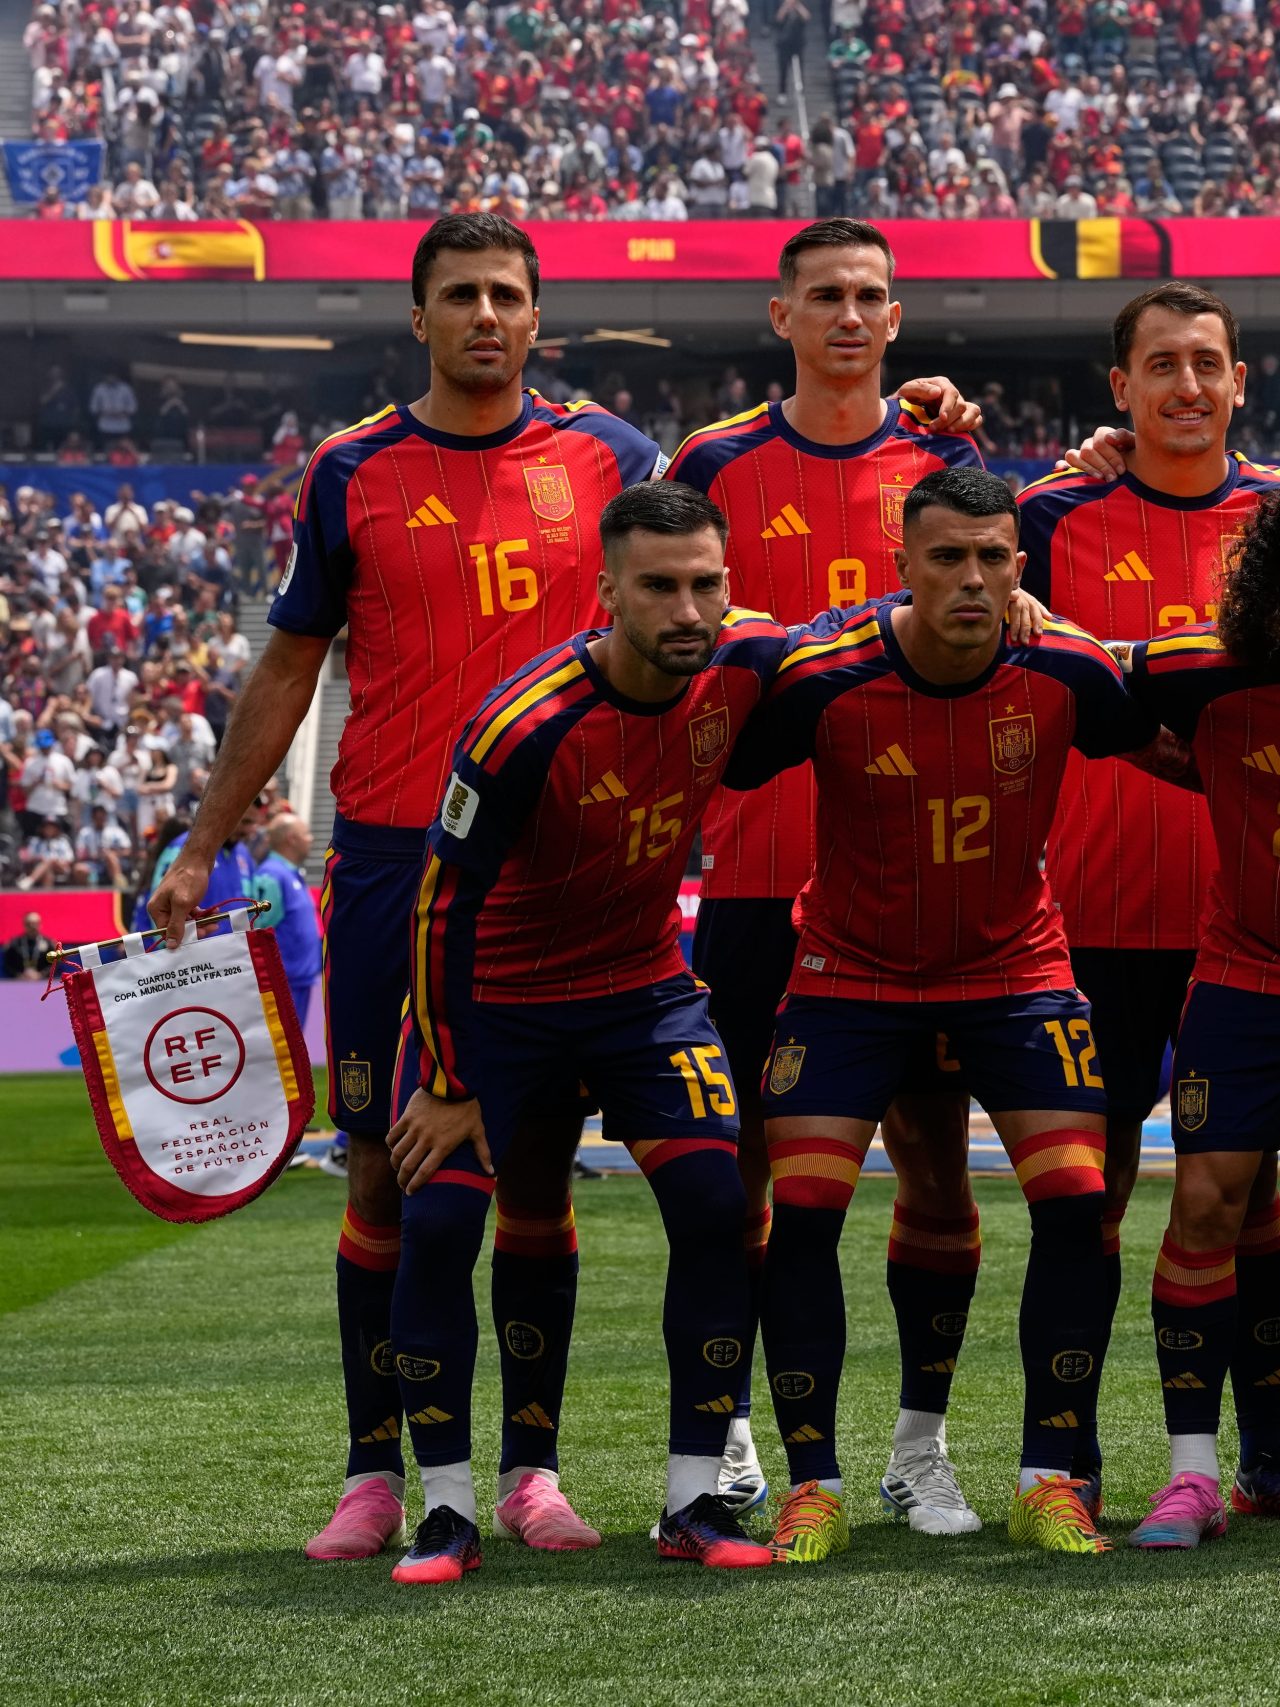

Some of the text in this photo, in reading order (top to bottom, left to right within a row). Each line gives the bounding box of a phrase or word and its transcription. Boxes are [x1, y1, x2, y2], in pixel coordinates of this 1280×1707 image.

[469, 539, 538, 615] 16
[828, 558, 867, 607] 8
[626, 791, 684, 866] 15
[928, 795, 990, 864] 12
[114, 966, 242, 1003] COPA MUNDIAL DE LA FIFA 2026
[137, 962, 215, 987] CUARTOS DE FINAL
[1044, 1019, 1104, 1088] 12
[669, 1045, 737, 1119] 15
[161, 1120, 270, 1151] FEDERACIÓN
[189, 1116, 233, 1131] REAL
[174, 1136, 263, 1161] ESPAÑOLA
[174, 1150, 269, 1175] DE FÚTBOL
